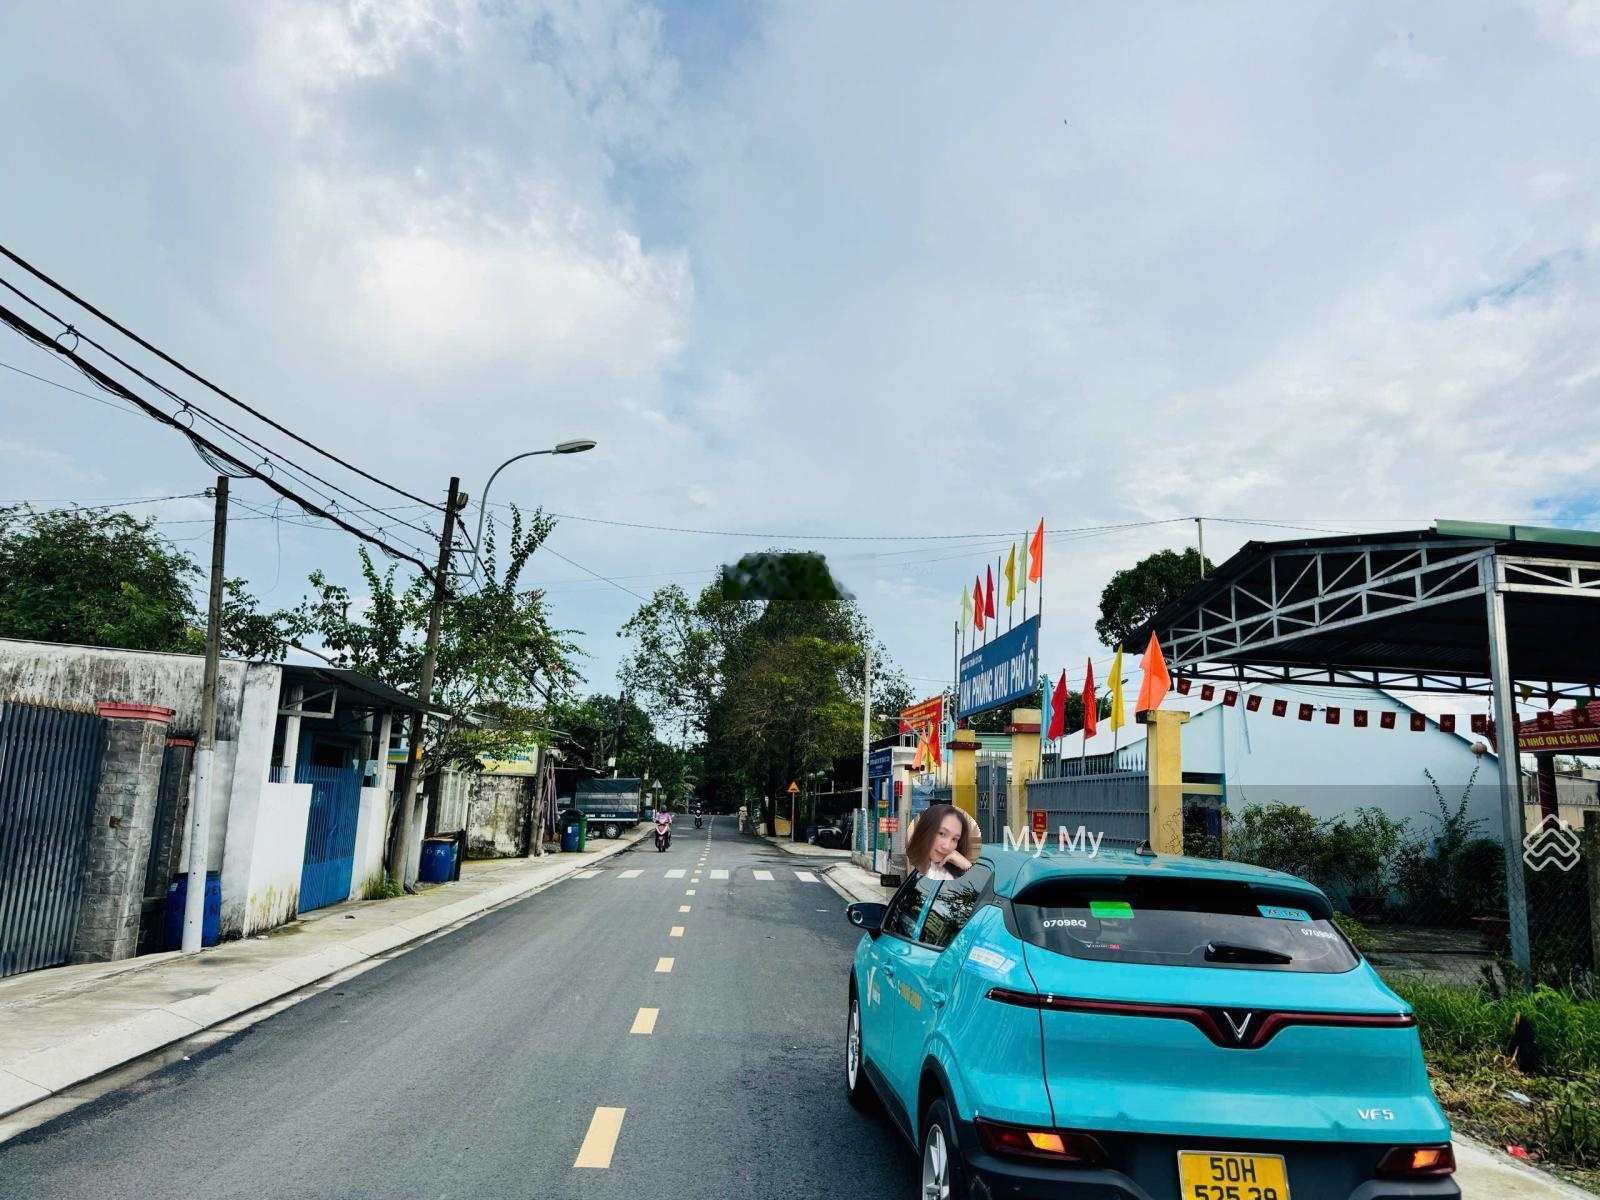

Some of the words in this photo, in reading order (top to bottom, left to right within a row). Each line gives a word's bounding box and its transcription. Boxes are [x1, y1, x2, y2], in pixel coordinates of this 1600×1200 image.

[972, 664, 993, 708] PHÒNG
[994, 661, 1009, 700] KHU
[1010, 635, 1028, 694] PHỐ
[1028, 648, 1034, 687] 6
[1528, 736, 1545, 747] NHỚ
[1560, 733, 1577, 744] CÁC
[1580, 733, 1599, 743] ANH
[1043, 919, 1087, 928] 07098Q
[1358, 1108, 1395, 1121] VF5
[1210, 1157, 1256, 1183] 50H
